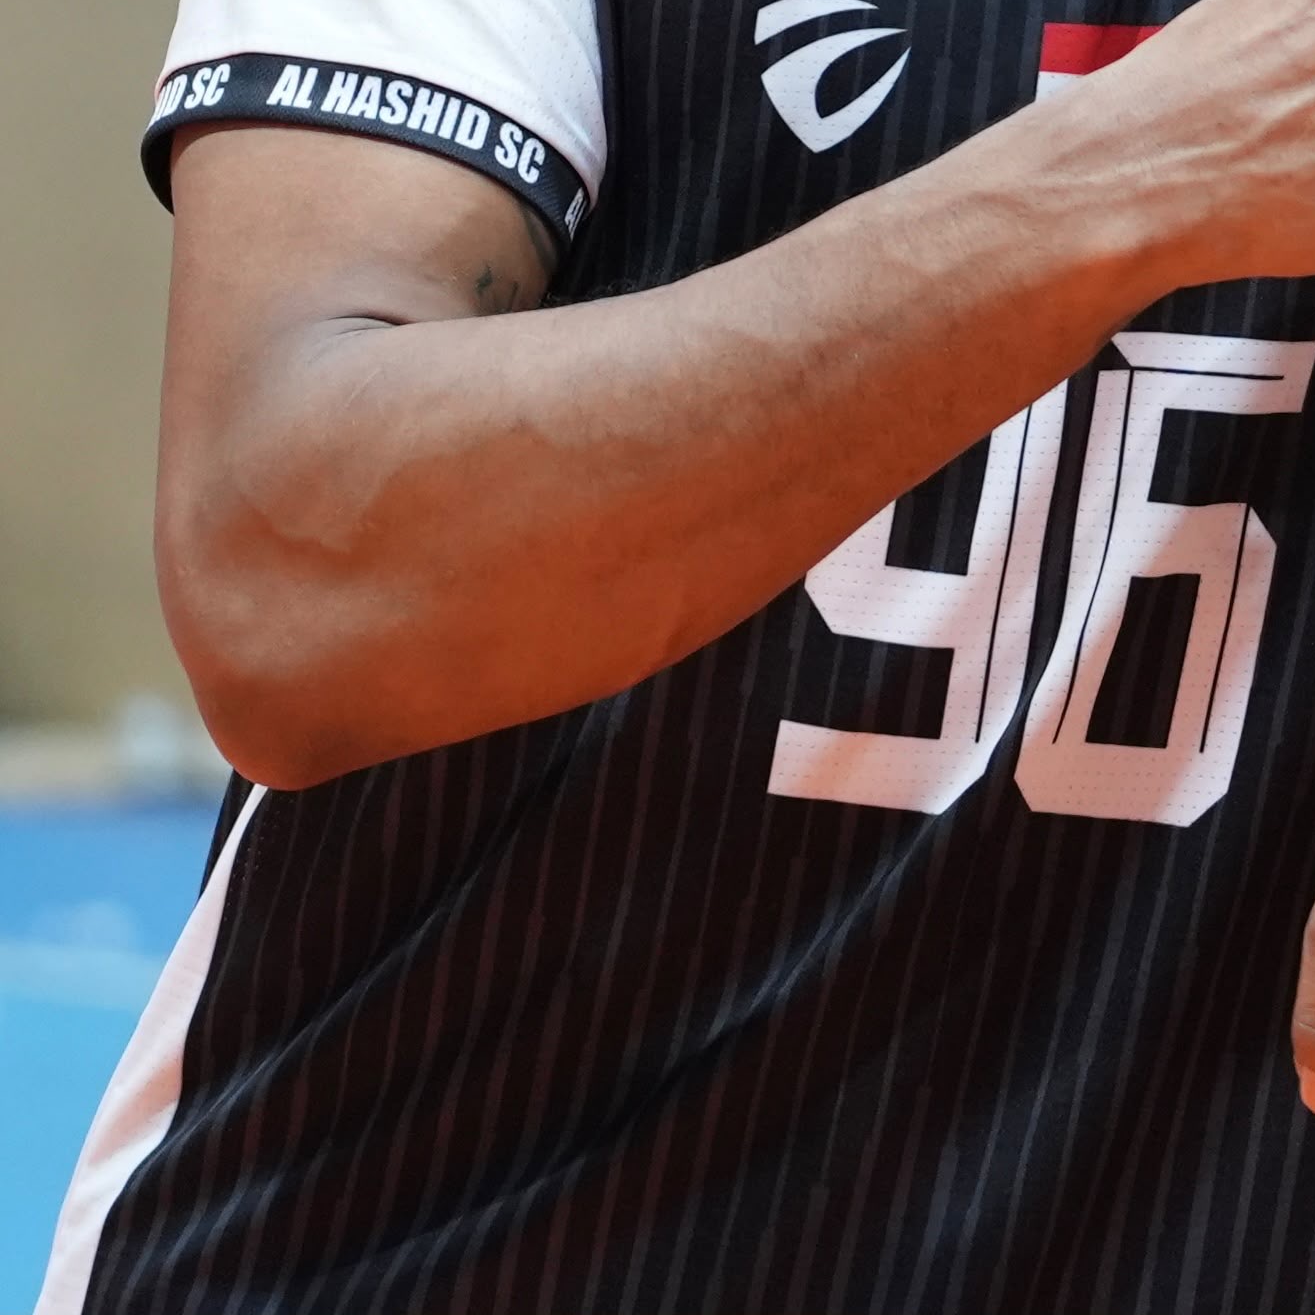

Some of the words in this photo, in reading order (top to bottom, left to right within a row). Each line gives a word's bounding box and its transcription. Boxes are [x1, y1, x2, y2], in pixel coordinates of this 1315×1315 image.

[184, 63, 231, 109] SC
[266, 64, 319, 109] AL
[320, 71, 491, 150] HASHID
[494, 121, 545, 184] SC
